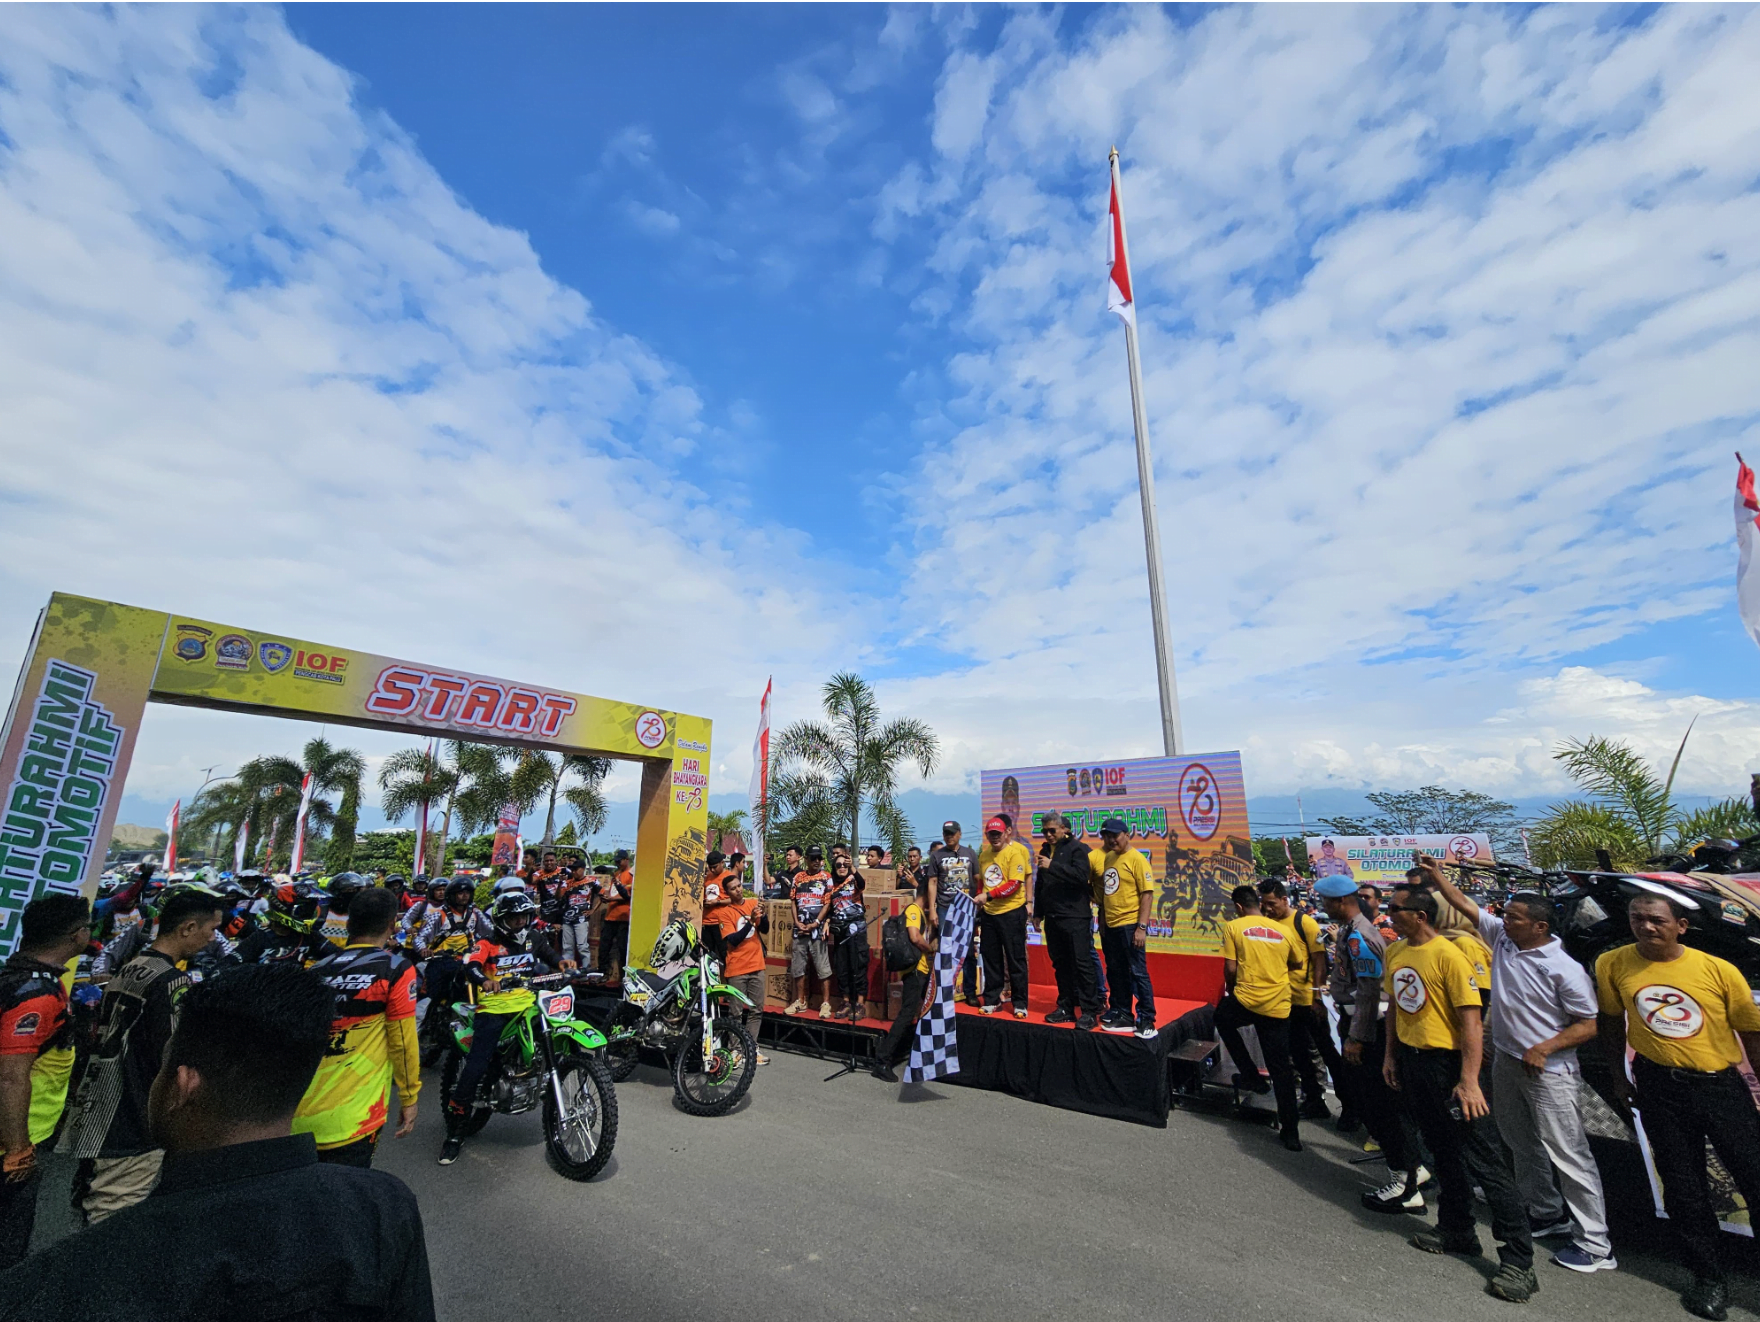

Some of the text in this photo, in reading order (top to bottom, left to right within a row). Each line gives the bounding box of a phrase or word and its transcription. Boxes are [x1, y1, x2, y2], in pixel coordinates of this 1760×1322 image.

[295, 650, 347, 673] IOF
[368, 667, 575, 735] START
[683, 759, 700, 771] HARI
[673, 771, 708, 786] BHAYANGKARA
[1105, 767, 1126, 785] IOF
[1347, 848, 1446, 860] SILATURAMI
[1361, 860, 1418, 872] OTOMO
[496, 953, 535, 967] BTA
[548, 996, 572, 1015] 29
